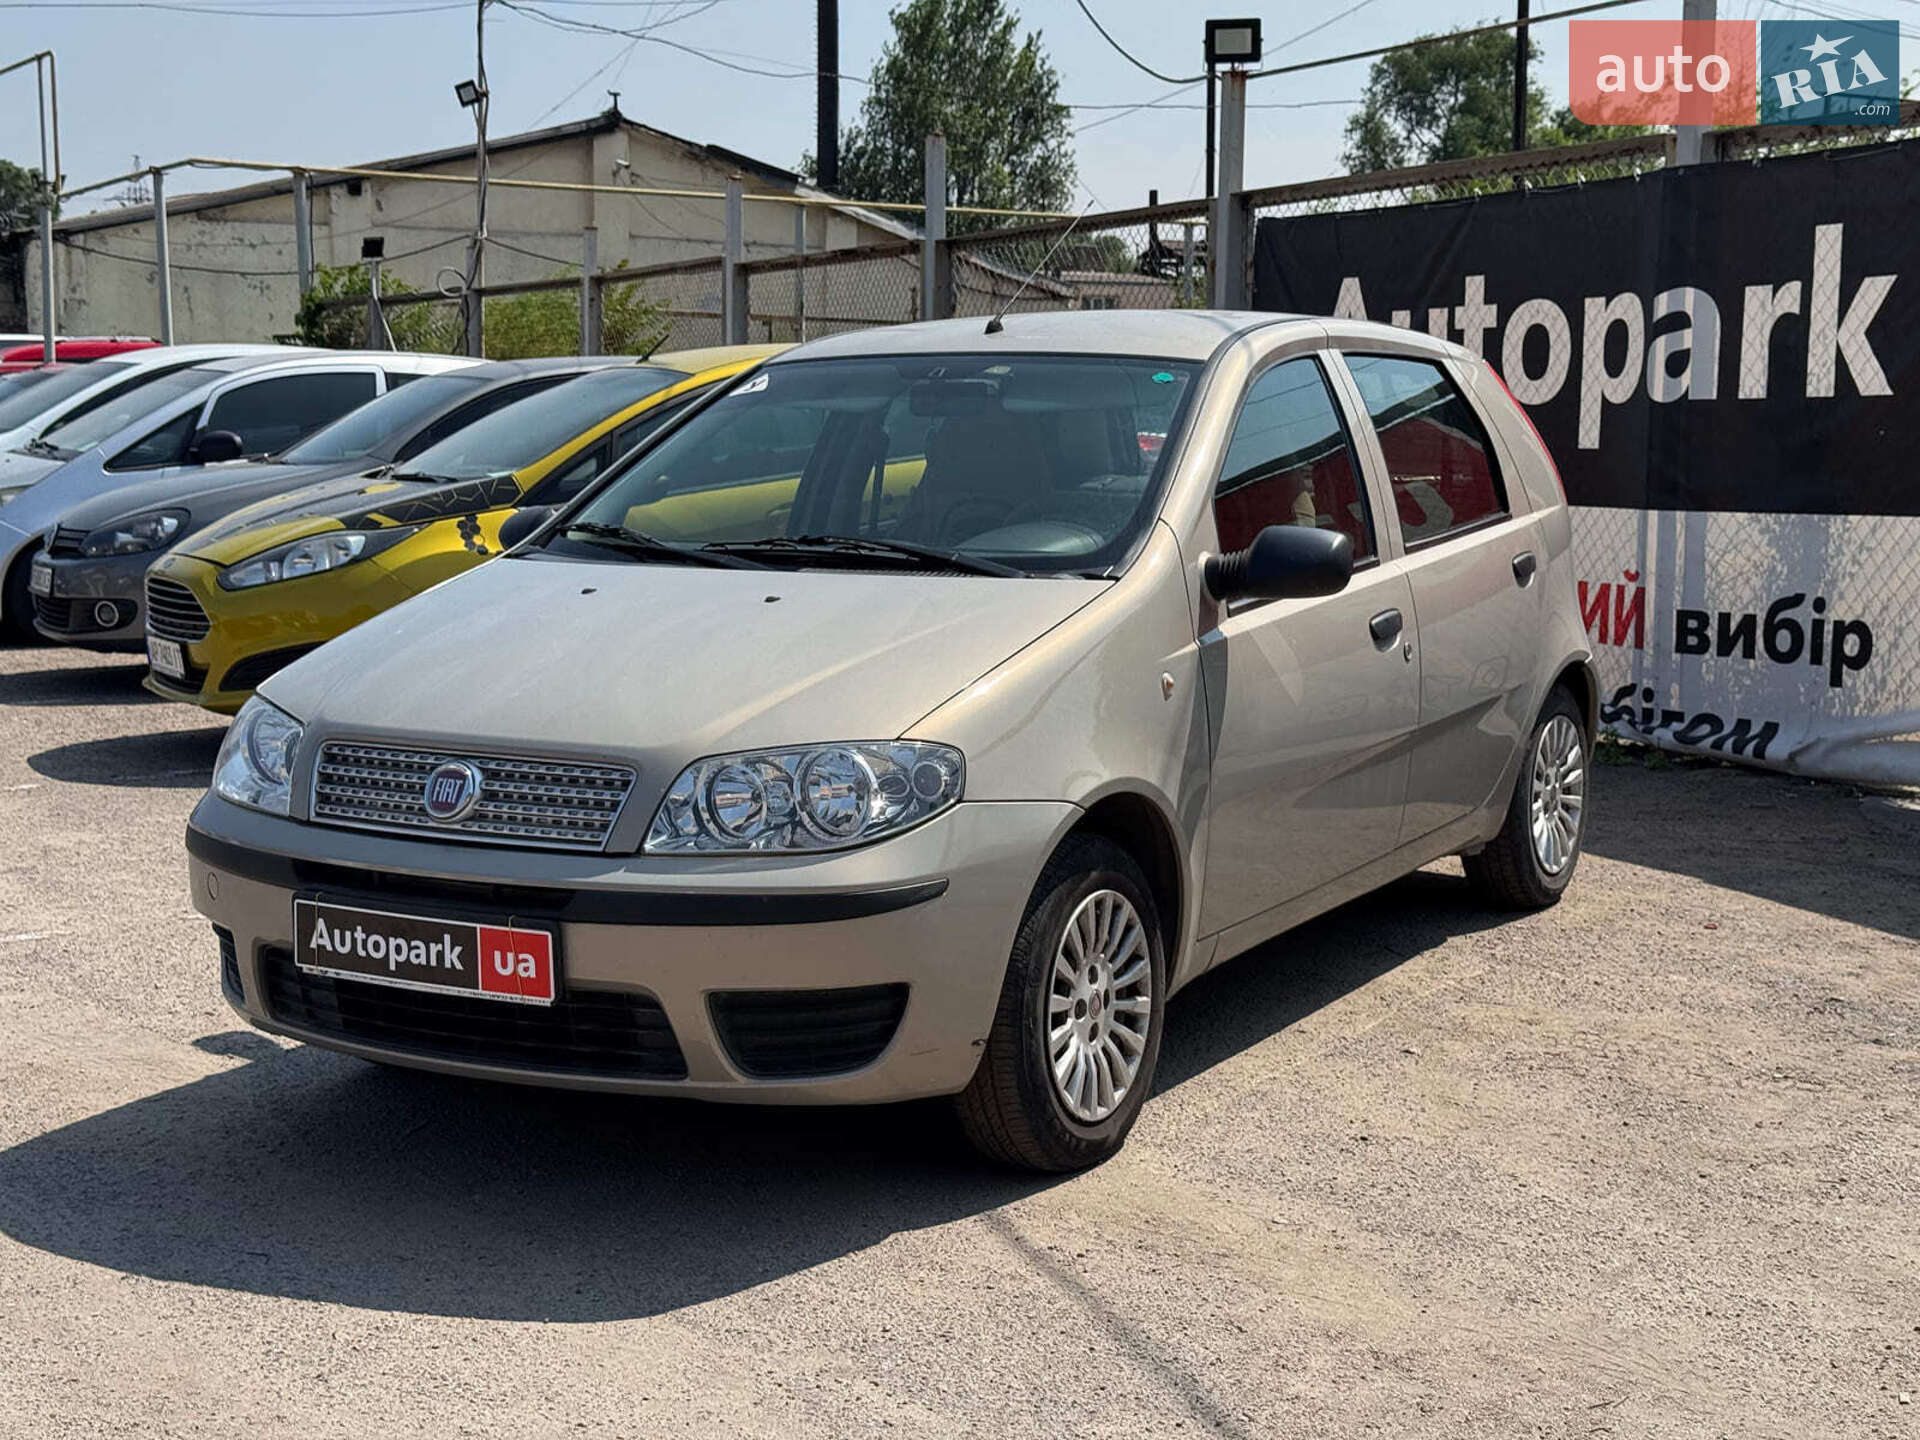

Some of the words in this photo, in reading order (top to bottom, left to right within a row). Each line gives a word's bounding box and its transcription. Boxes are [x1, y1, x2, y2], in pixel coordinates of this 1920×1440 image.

[1674, 592, 1874, 688] вибір
[433, 777, 463, 804] FIAT
[309, 917, 465, 972] Autopark
[493, 948, 537, 979] ua
